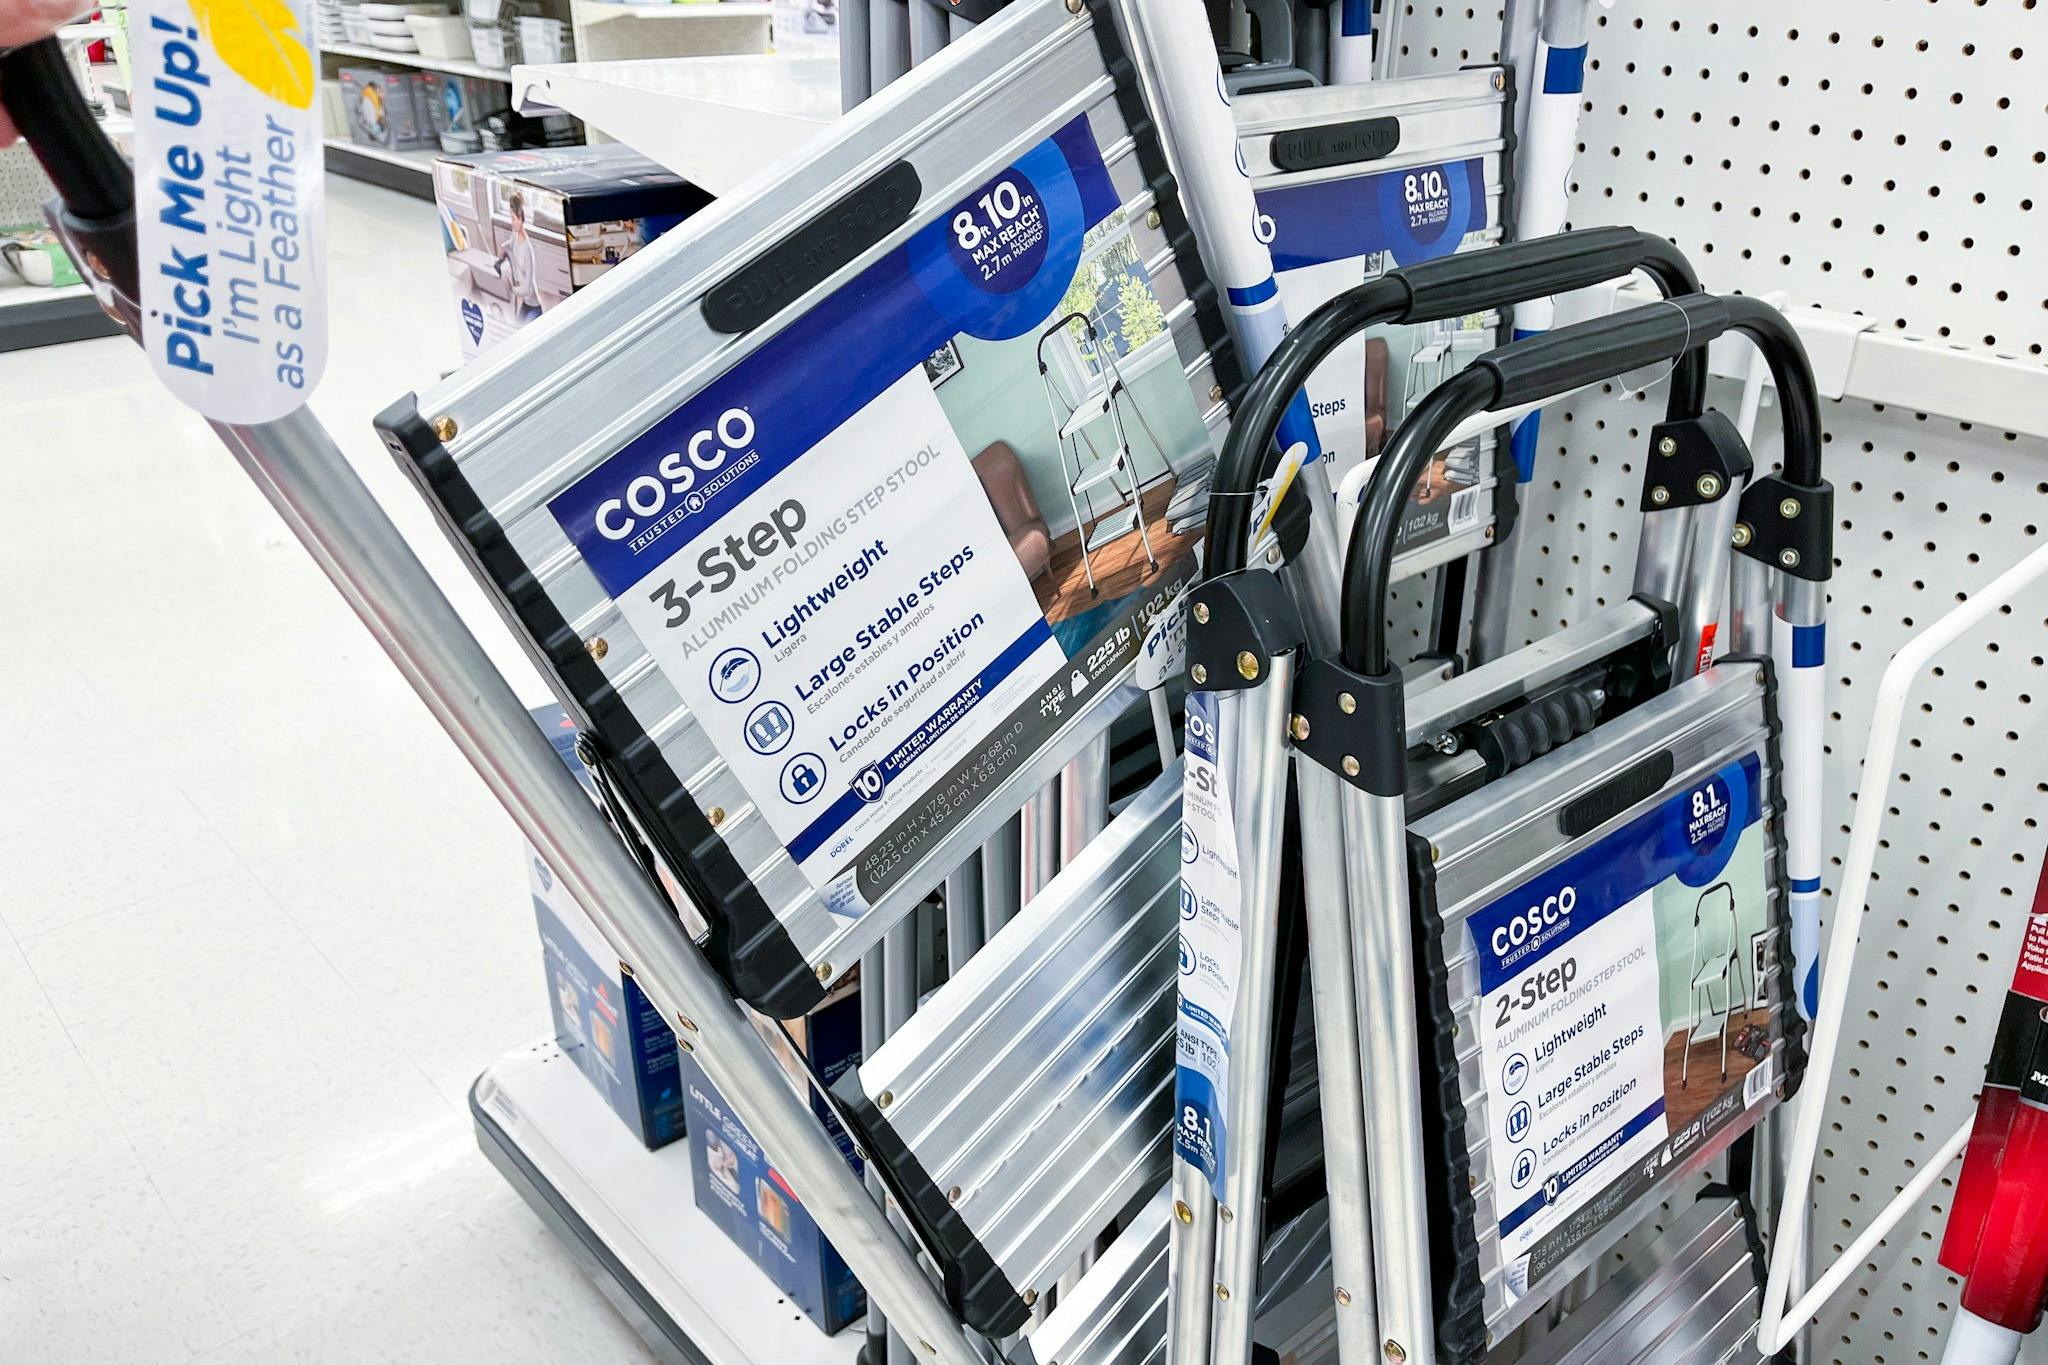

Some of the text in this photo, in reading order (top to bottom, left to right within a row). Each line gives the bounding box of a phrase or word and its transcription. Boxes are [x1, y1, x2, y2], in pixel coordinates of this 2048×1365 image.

[150, 15, 214, 376] Pick Me Up!
[214, 145, 262, 264] Light
[1409, 202, 1425, 215] MAX
[258, 113, 304, 389] as a Feather
[972, 237, 1001, 265] MAX
[1009, 220, 1044, 251] ALCANCE
[1312, 398, 1346, 418] Steps
[595, 406, 756, 540] COSCO
[629, 451, 760, 553] TRUSTED SOLUTIONS
[1409, 515, 1426, 532] 102
[1426, 512, 1440, 526] kg
[649, 498, 807, 629] 3-Step
[681, 445, 941, 660] ALUMINUM FOLDING STEP STOOL
[761, 538, 889, 649] Lightweight
[1137, 578, 1184, 624] 102 kg
[774, 633, 808, 663] Ligera
[794, 545, 975, 701] Large Stable Steps
[1086, 626, 1131, 673] 225 lb
[806, 672, 856, 715] Escalones
[854, 639, 893, 675] estables
[899, 603, 935, 637] amplios
[828, 612, 985, 752] Locks in Position
[1091, 641, 1131, 680] LOAD CAPACITY
[839, 649, 967, 763] Candado de seguridad al abrir
[1039, 688, 1067, 717] TYPE
[1040, 683, 1062, 707] ANSI
[1053, 705, 1063, 717] 2
[885, 731, 926, 770] LIMITED
[925, 679, 984, 732] WARRANTY
[926, 721, 952, 746] LIMITADA
[949, 713, 959, 725] DE
[957, 707, 966, 718] 10
[854, 769, 881, 800] 10
[864, 721, 1024, 873] 48.23 in H x 17.8 in W x 2.68 in D
[830, 836, 854, 858] DOREL
[869, 849, 902, 884] (122.5
[901, 835, 921, 854] cm
[921, 828, 929, 837] x
[929, 805, 954, 827] 45.2
[953, 789, 971, 807] cm
[970, 782, 979, 791] x
[978, 764, 996, 782] 6.8
[1689, 816, 1704, 833] MAX
[1491, 886, 1577, 957] COSCO
[1501, 919, 1571, 967] TRUSTED SOLUTIONS
[2029, 933, 2037, 942] to
[2030, 923, 2047, 935] Pull
[1495, 957, 1577, 1030] 2-Step
[1496, 945, 1647, 1052] ALUMINUM FOLDING STEP STOOL
[1534, 1002, 1608, 1062] Lightweight
[1538, 1024, 1644, 1108] Large Stable Steps
[1543, 1077, 1637, 1156] Locks in Position
[1562, 1158, 1588, 1183] LIMITED
[1587, 1130, 1624, 1162] WARRANTY
[1544, 1177, 1558, 1202] 10
